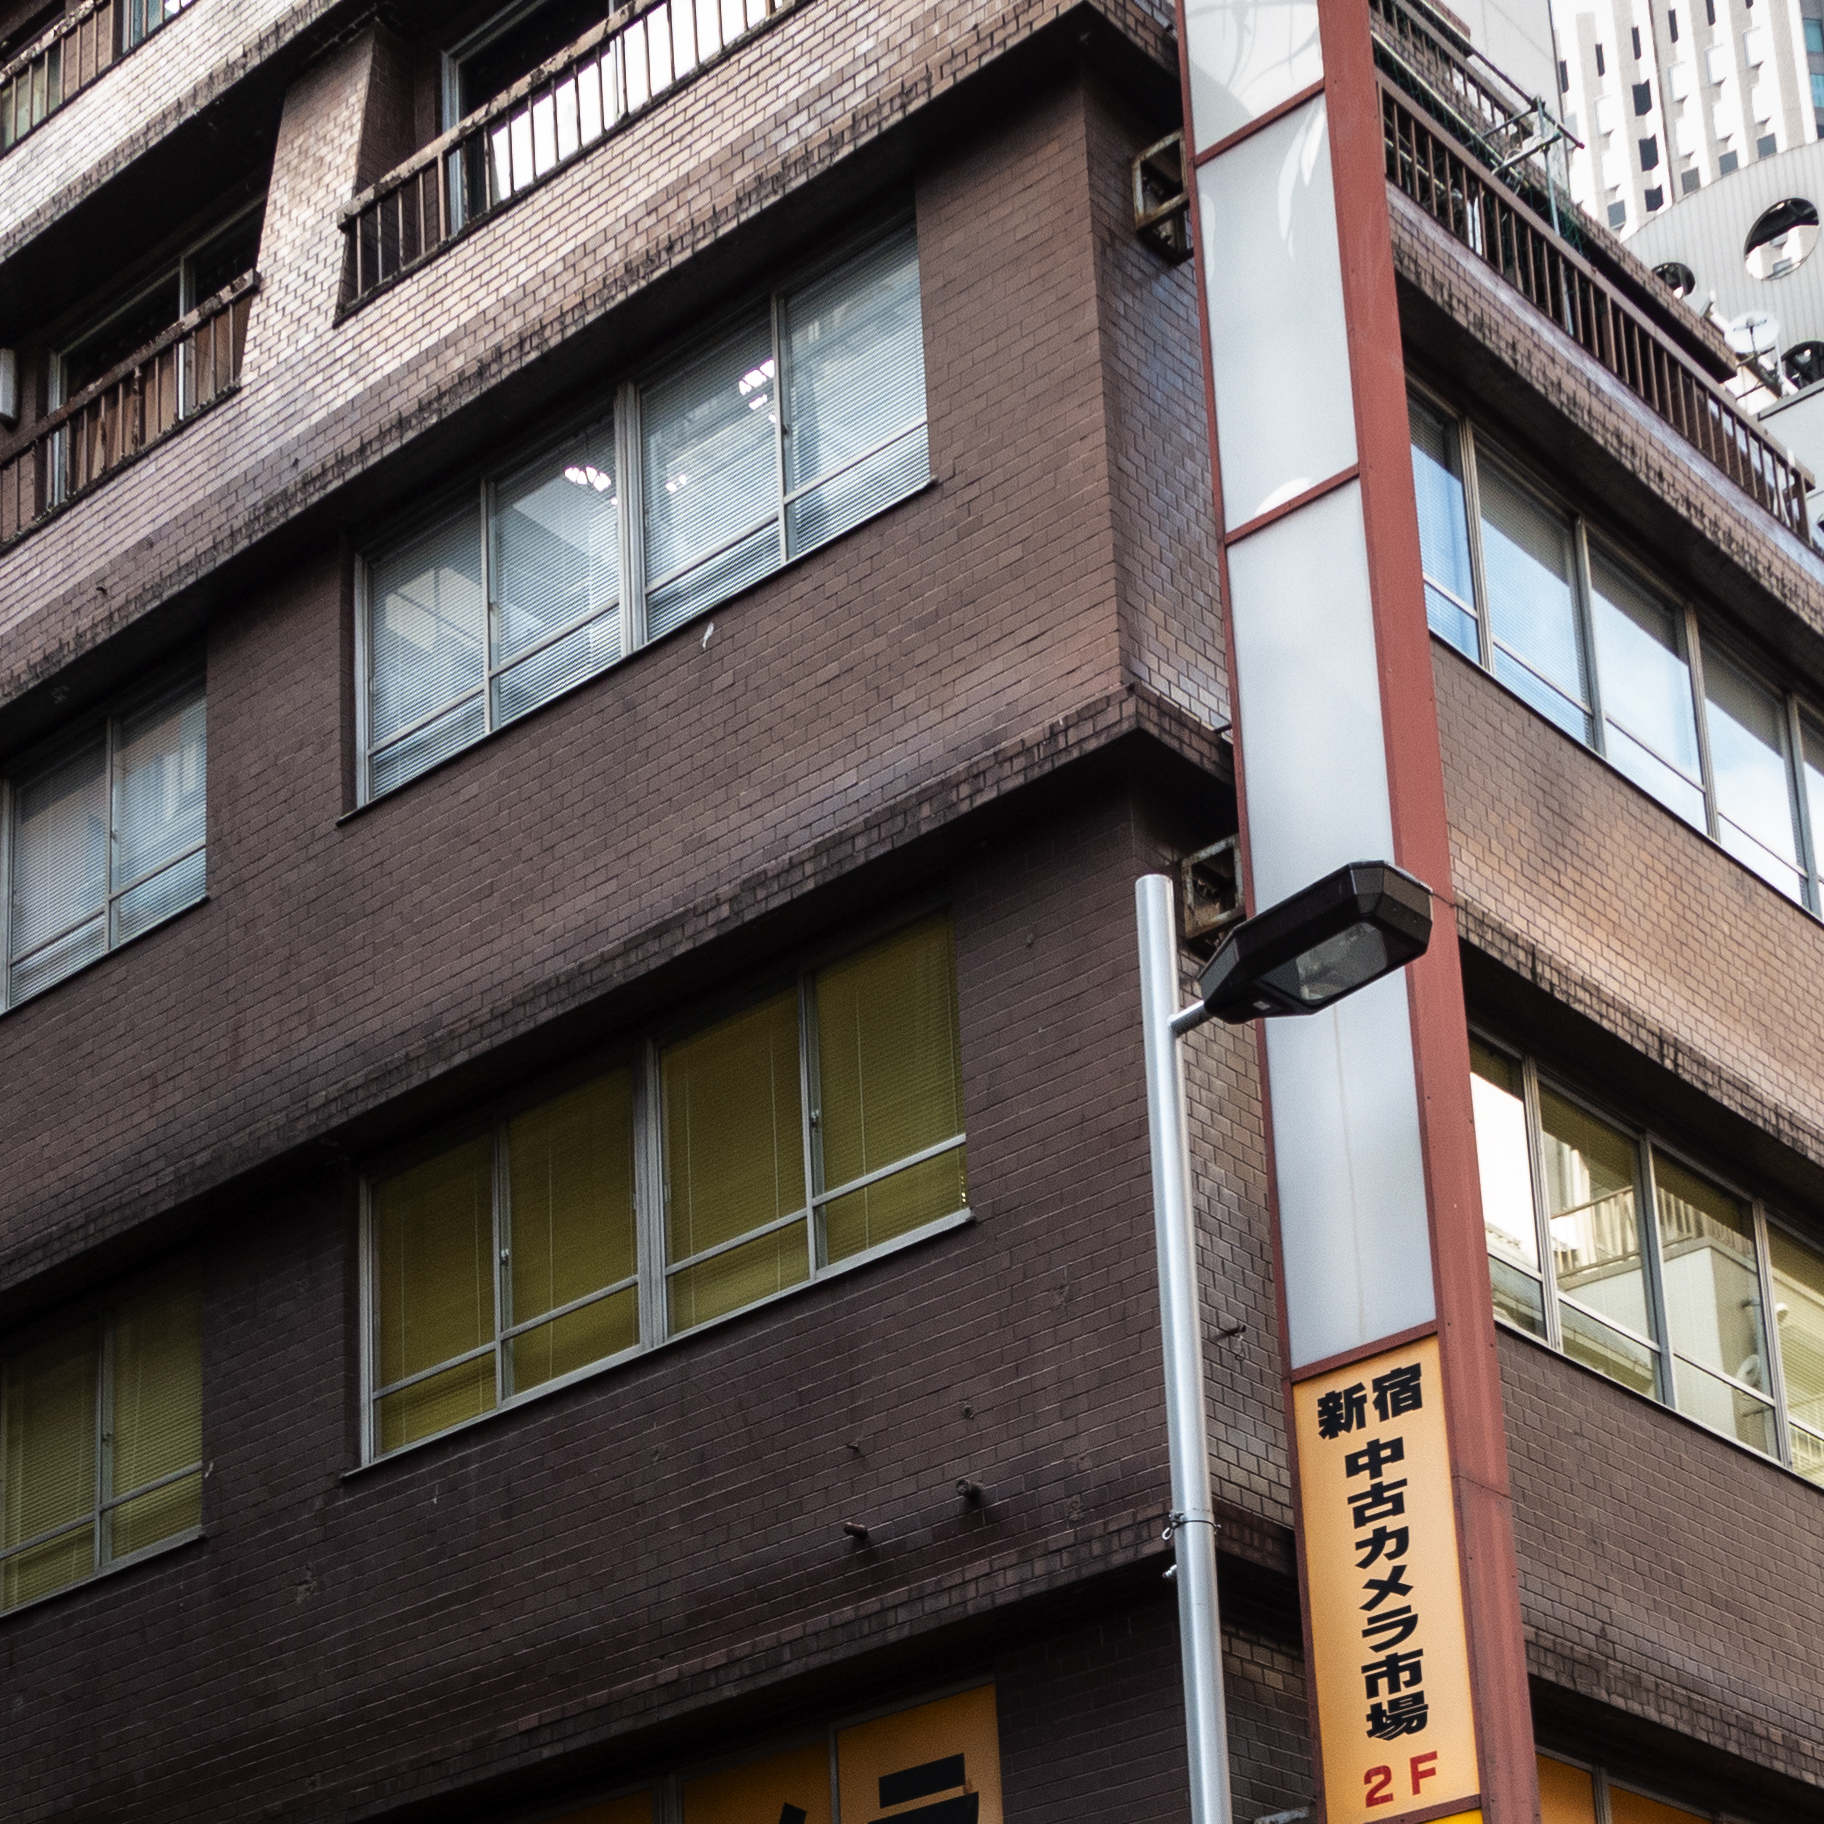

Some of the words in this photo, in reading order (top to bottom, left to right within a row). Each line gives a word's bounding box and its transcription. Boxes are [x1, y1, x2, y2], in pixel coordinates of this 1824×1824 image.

[1317, 1363, 1424, 1442] 新宿
[1343, 1437, 1429, 1743] 中古カメラ市場
[1363, 1750, 1441, 1808] 2F
